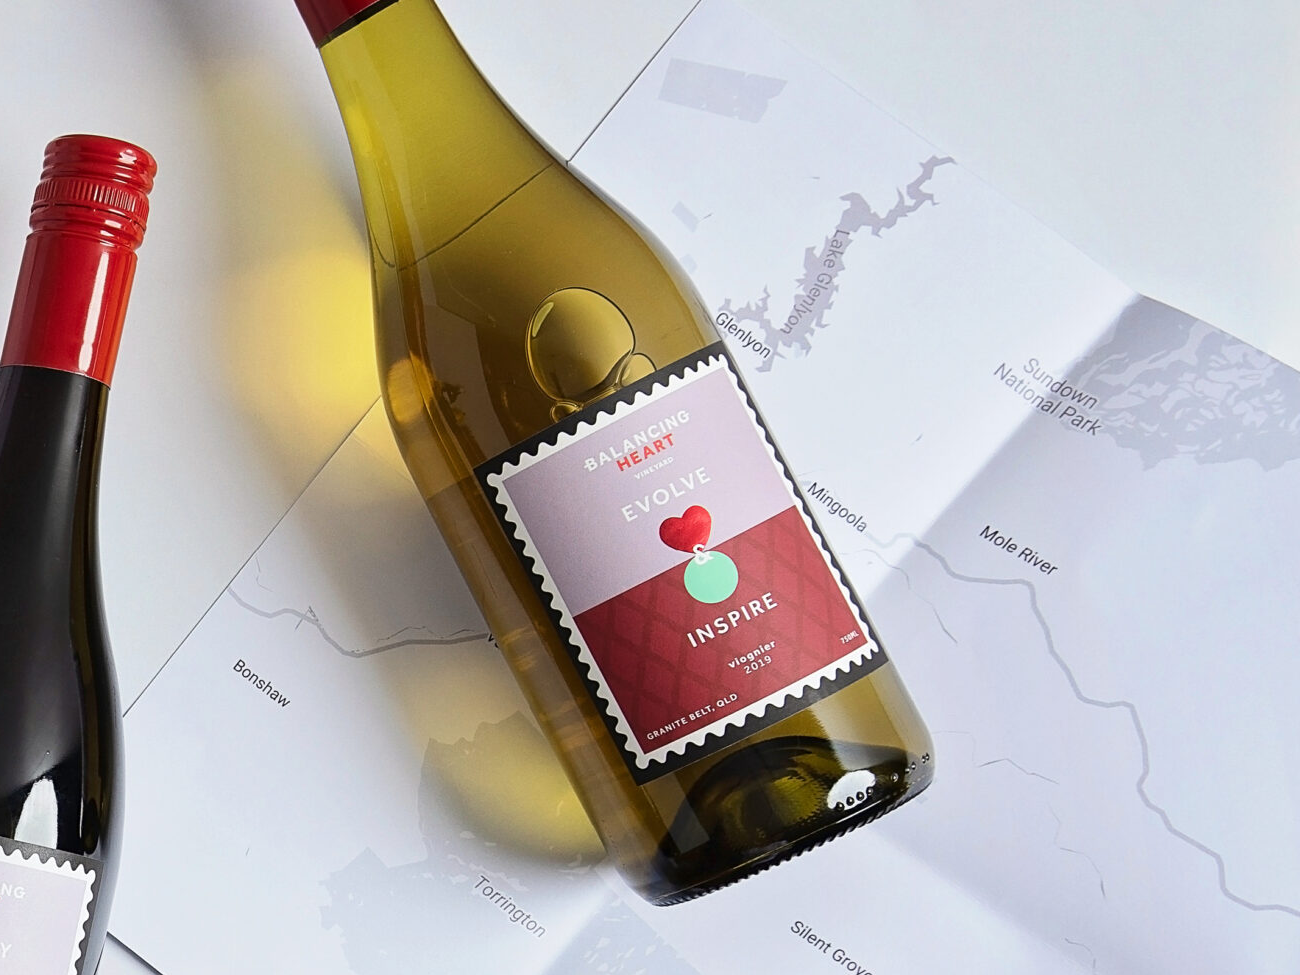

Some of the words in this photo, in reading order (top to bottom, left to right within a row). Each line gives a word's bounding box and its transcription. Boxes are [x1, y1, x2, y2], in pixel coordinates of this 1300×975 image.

[822, 228, 850, 269] Lake
[780, 272, 833, 335] Glenlyon
[714, 312, 772, 359] Glenlyon
[992, 362, 1062, 420] National
[1058, 404, 1102, 437] Park
[1022, 356, 1100, 410] Sundown
[582, 408, 691, 474] BALANCING
[615, 432, 676, 472] HEART
[633, 456, 674, 481] VINEYARD
[620, 466, 712, 523] EVOLVE
[806, 482, 868, 534] Mingoola
[978, 524, 1020, 558] Mole
[1016, 546, 1059, 576] River
[686, 592, 780, 648] INSPIRE
[840, 630, 860, 645] 750ML
[727, 639, 777, 670] viognier
[744, 654, 773, 676] 2019
[232, 658, 292, 709] Bonshaw
[646, 716, 689, 741] GRANITE
[688, 703, 716, 722] BELT,
[716, 692, 738, 710] QLD
[472, 874, 548, 938] Torrington
[790, 920, 832, 954] Silent
